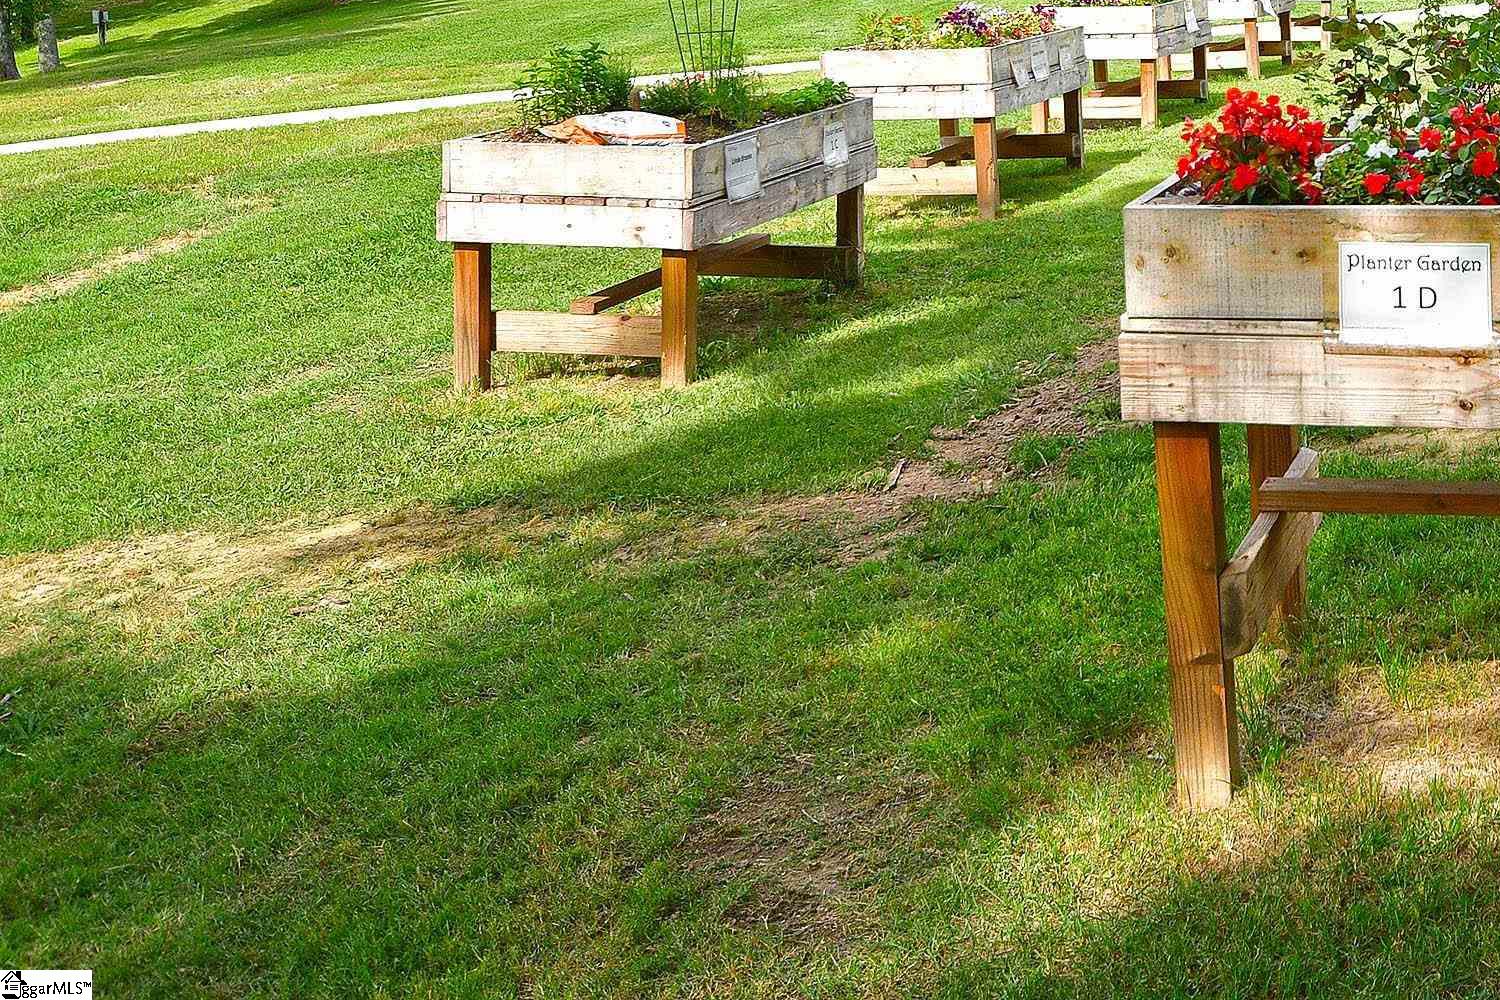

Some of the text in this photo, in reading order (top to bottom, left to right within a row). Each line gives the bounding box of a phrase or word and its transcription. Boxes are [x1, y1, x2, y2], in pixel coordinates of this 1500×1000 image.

[1347, 254, 1482, 273] Planter Garden
[1393, 286, 1437, 309] 1 D
